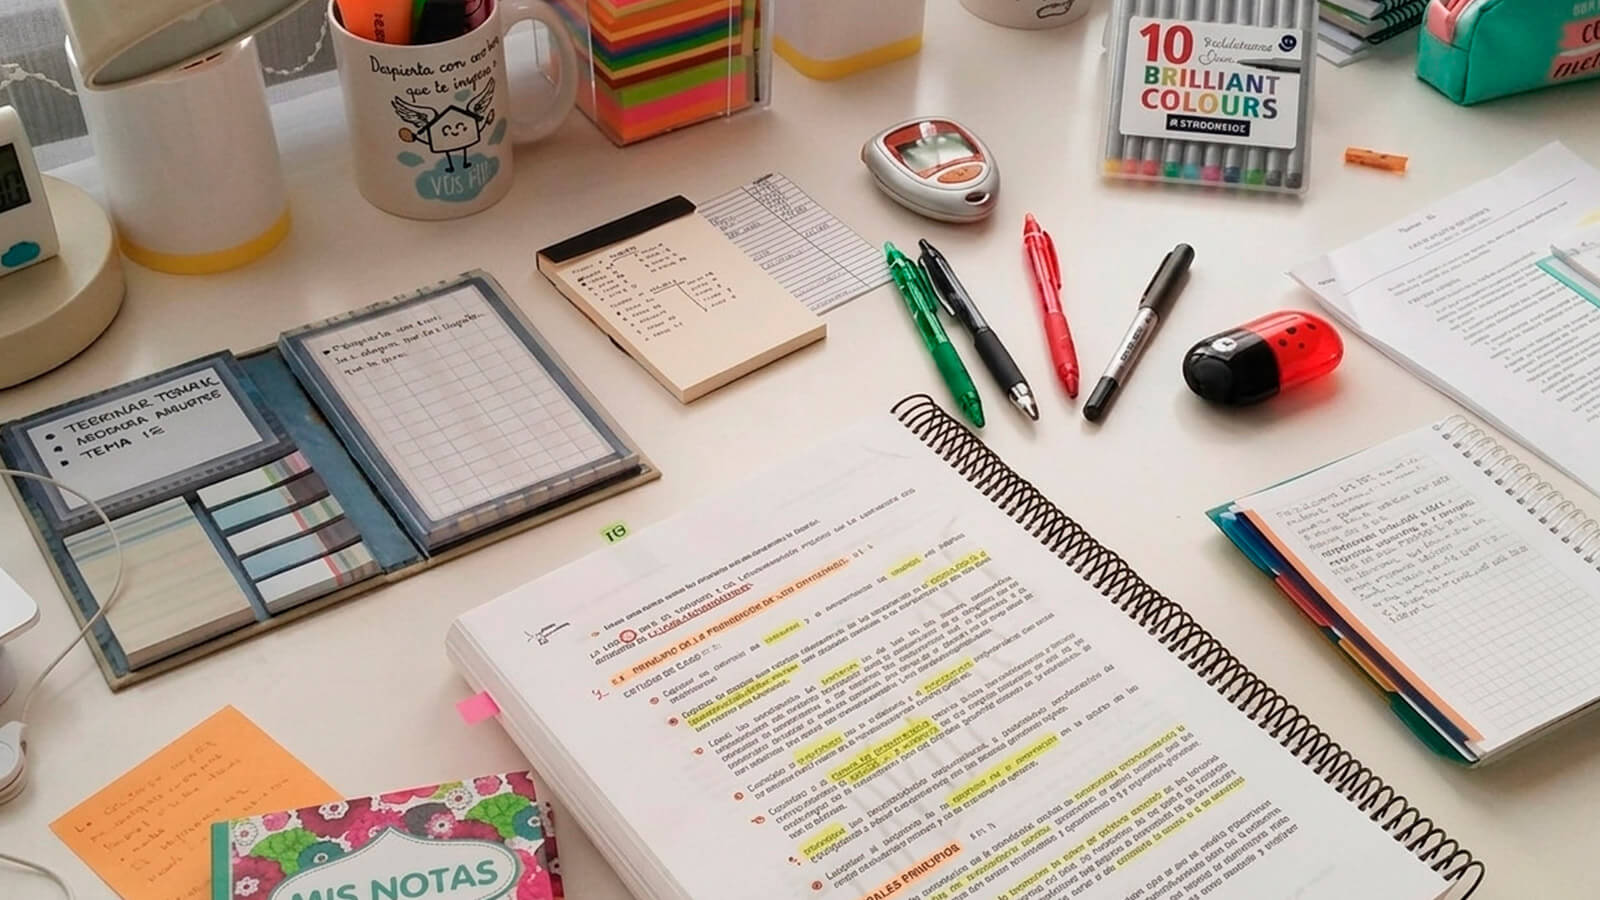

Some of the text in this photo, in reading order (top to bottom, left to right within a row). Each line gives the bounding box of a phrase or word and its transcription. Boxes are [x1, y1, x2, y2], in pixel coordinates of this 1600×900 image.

[1139, 22, 1194, 65] 10
[1144, 65, 1280, 96] BRILLIANT
[1141, 88, 1278, 119] COLOURS
[371, 860, 499, 900] NOTAS
